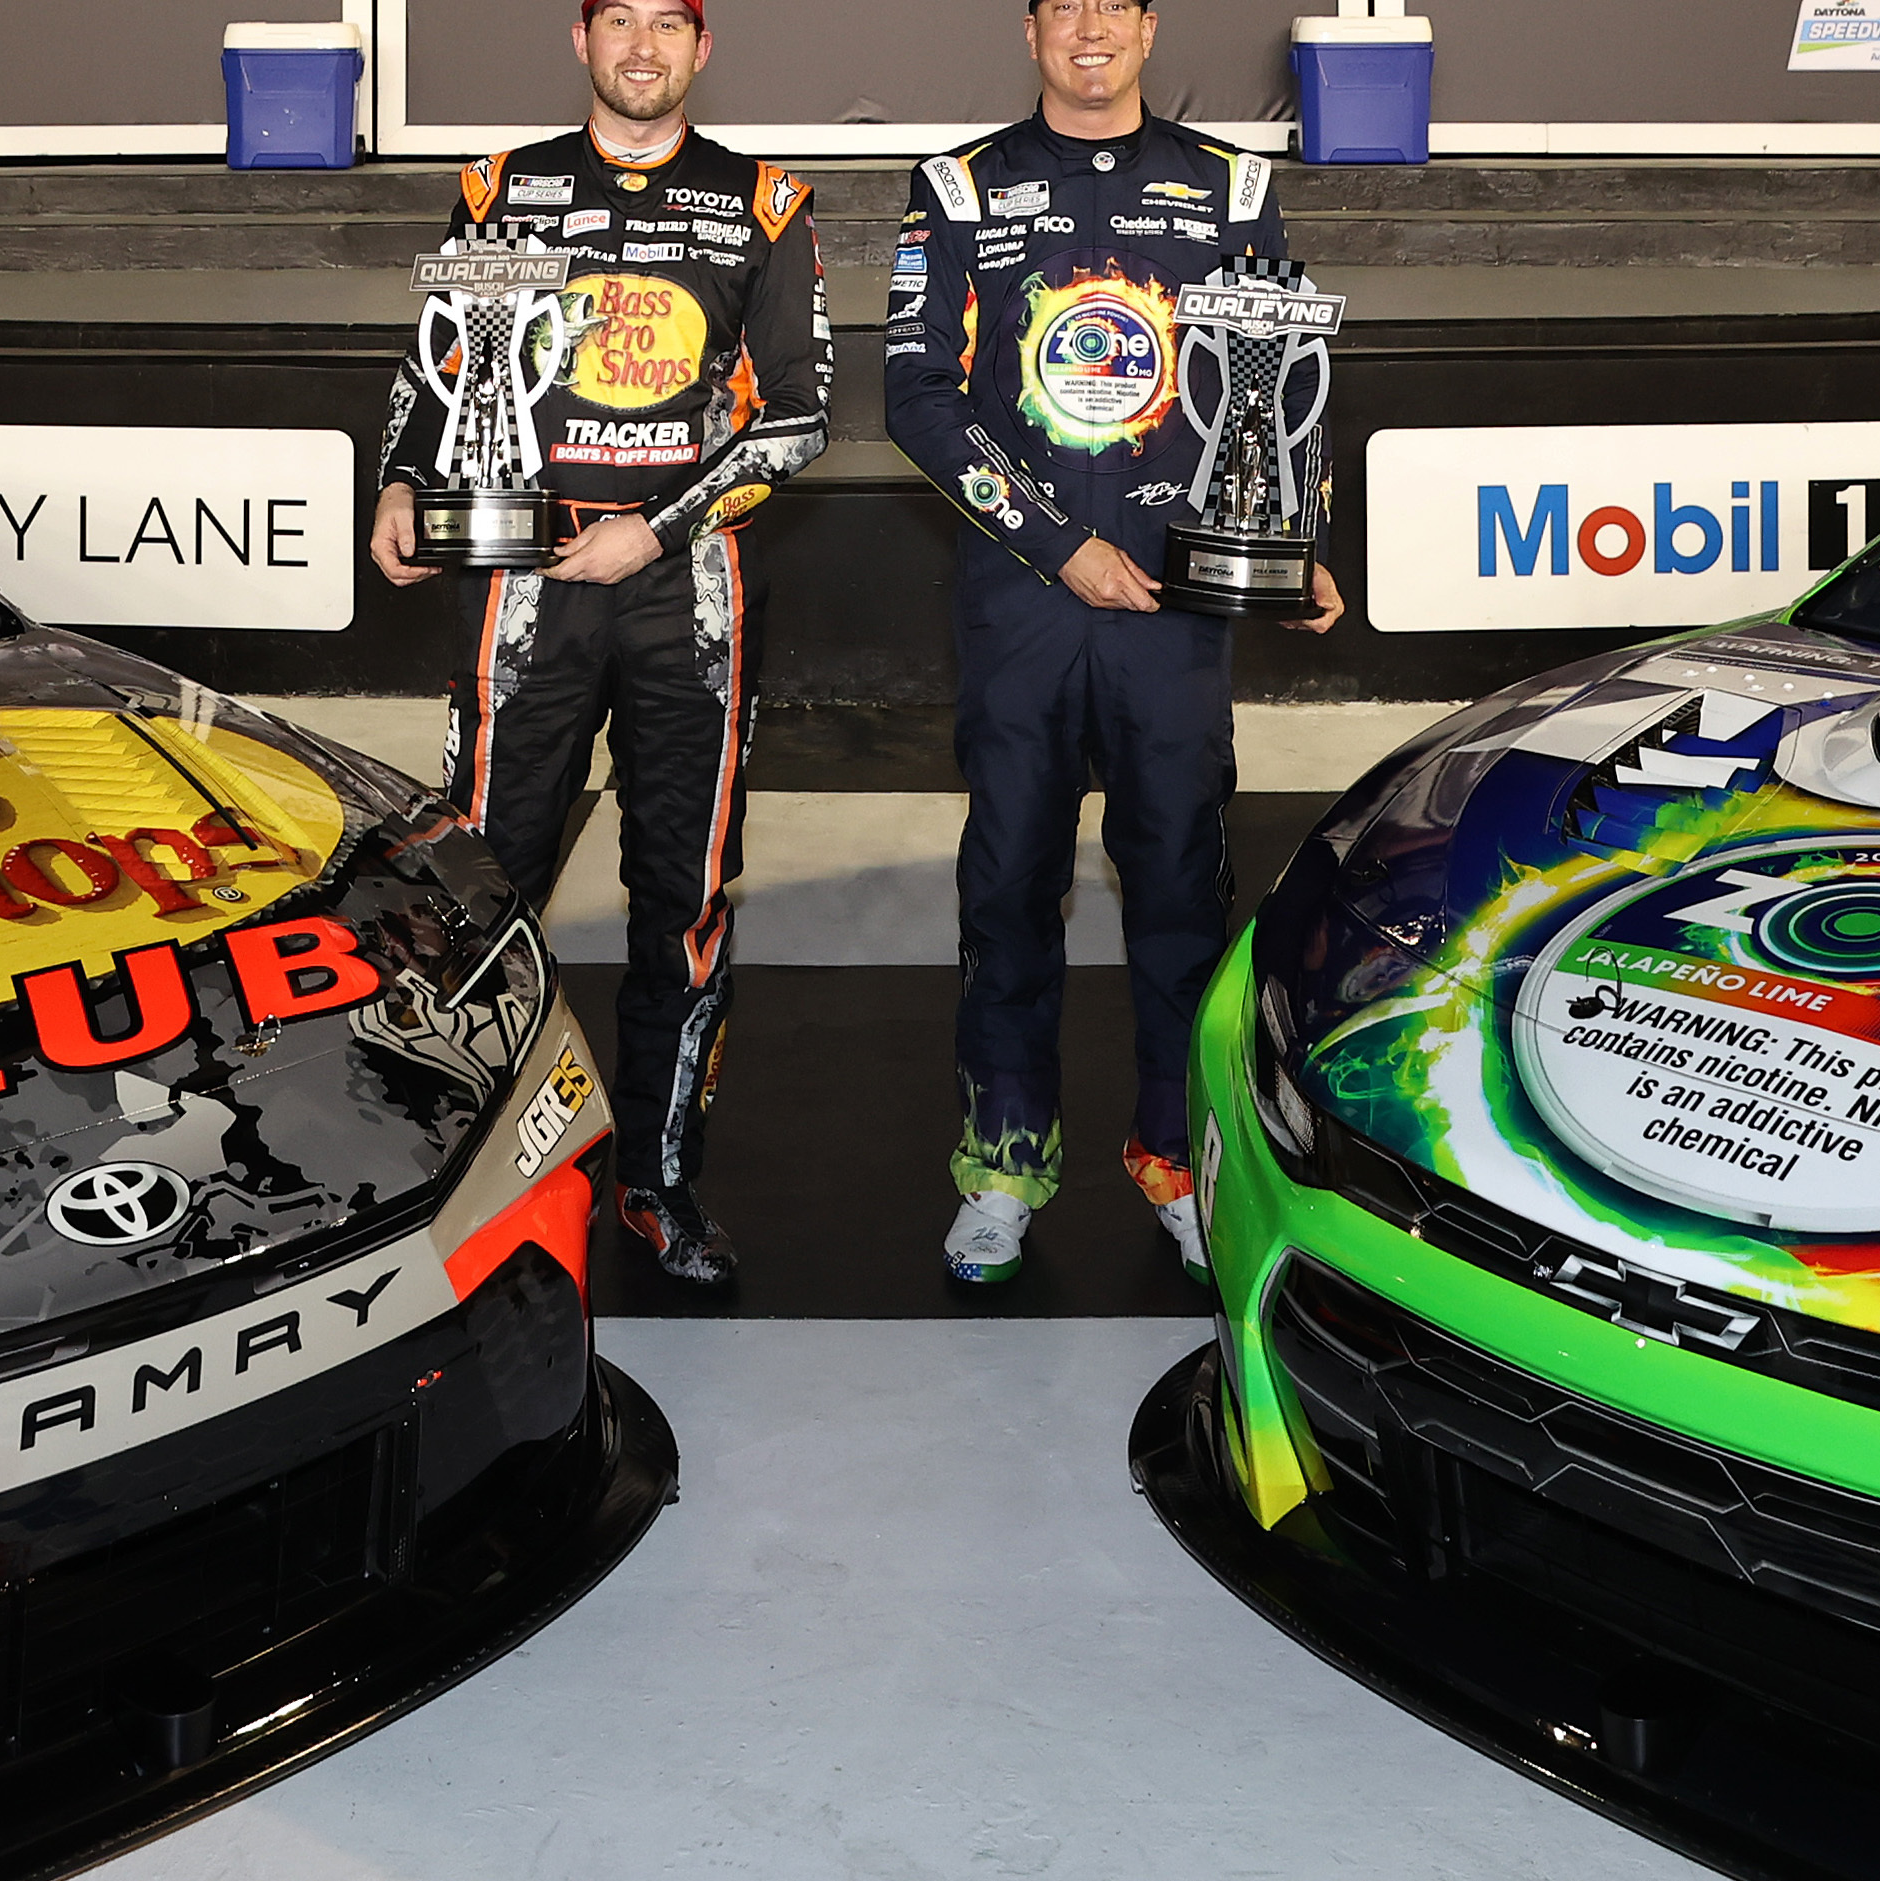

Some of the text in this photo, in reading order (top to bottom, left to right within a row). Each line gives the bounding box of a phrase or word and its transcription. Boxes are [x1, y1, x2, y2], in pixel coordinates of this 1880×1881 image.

[1814, 8, 1865, 16] DAYTONA
[535, 190, 563, 198] SERIES
[935, 161, 965, 207] sparco
[1239, 160, 1262, 208] sparco
[665, 188, 744, 210] TOYOTA
[1141, 197, 1214, 213] CHEVROLET
[567, 214, 606, 228] Lance
[657, 220, 688, 232] BIRD
[692, 219, 752, 241] REDHEAD
[975, 224, 1027, 241] LUCAS OIL
[1034, 216, 1075, 233] FICO
[1109, 215, 1167, 231] Cheddar's
[1173, 217, 1218, 238] REBEL
[546, 244, 616, 263] GOODYEAR
[626, 245, 664, 259] Mobil
[420, 261, 559, 282] QUALIFYING
[474, 282, 504, 292] BUSCH
[596, 278, 673, 318] Bass
[1184, 294, 1334, 324] QUALIFYING
[597, 316, 655, 353] Pro
[1241, 320, 1274, 332] BUSCH
[1055, 325, 1150, 362] zone
[596, 349, 692, 397] Shops
[1126, 360, 1152, 377] 6 MG
[565, 419, 690, 448] TRACKER
[556, 446, 695, 463] BOATS & OFF ROAD
[722, 487, 755, 514] Bass
[958, 464, 1024, 530] zone
[77, 494, 309, 567] LANE
[1478, 481, 1779, 577] Mobil
[1704, 640, 1858, 670] WARNING:
[1575, 946, 1834, 1012] JALAPEÑO LIME
[1609, 997, 1779, 1057] WARNING:
[1784, 1037, 1854, 1078] This
[1563, 1023, 1690, 1073] contains
[1697, 1056, 1832, 1112] nicotine.
[1627, 1071, 1864, 1163] is an addictive
[1643, 1116, 1799, 1182] chemical
